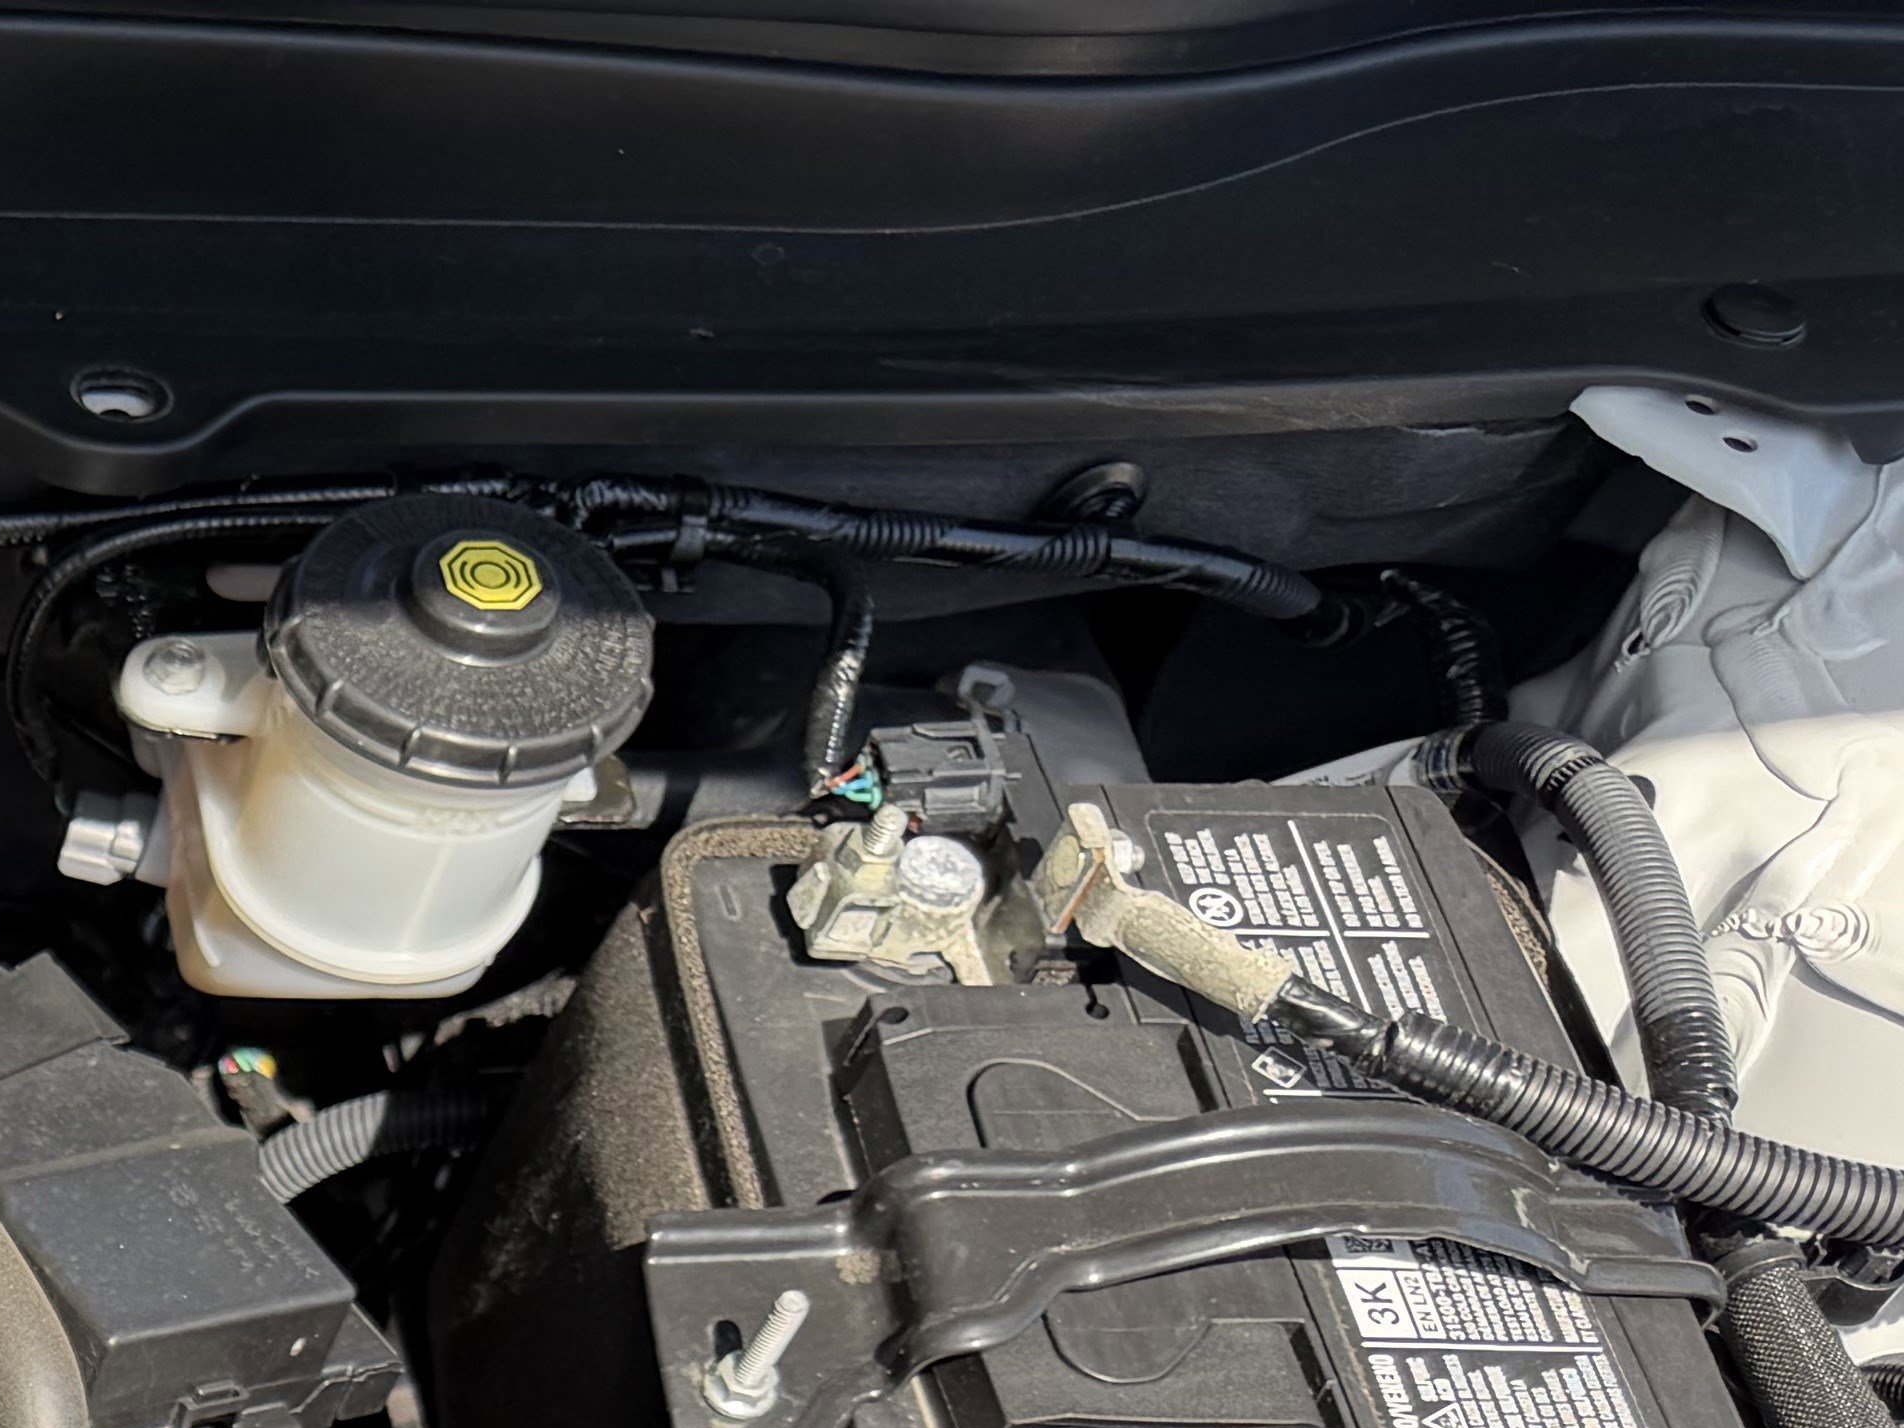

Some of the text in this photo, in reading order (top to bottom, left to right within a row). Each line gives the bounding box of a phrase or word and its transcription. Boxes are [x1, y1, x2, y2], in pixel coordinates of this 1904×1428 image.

[1355, 1283, 1398, 1323] 3K
[1410, 1279, 1437, 1331] EN LN2
